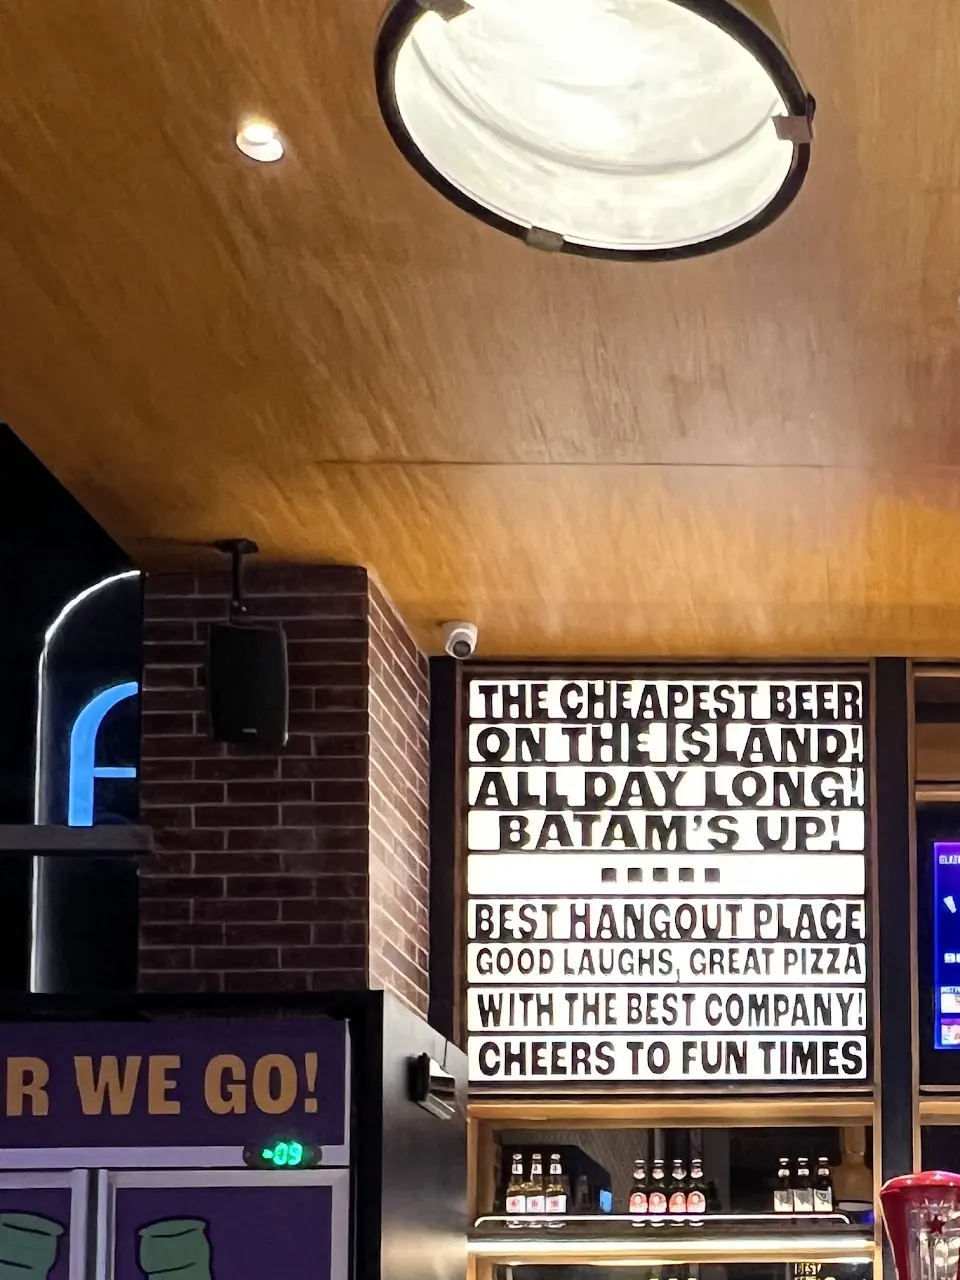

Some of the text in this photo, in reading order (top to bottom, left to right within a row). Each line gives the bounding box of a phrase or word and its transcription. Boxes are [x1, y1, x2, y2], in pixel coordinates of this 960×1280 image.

[478, 683, 860, 719] THE CHEAPEST BEER
[477, 727, 860, 762] ON THE ISLAND!
[475, 771, 860, 807] ALL DAY LONG!
[500, 815, 840, 850] BATAM'S UP!
[476, 904, 860, 938] BEST HANGOUT PLACE
[477, 949, 861, 981] GOOD LAUGHS, GREAT PIZZA
[478, 993, 863, 1026] WITH THE BEST COMPANY!
[478, 1041, 862, 1075] CHEERS TO FUN TIMES
[74, 1056, 181, 1115] WE
[204, 1053, 318, 1114] GO!
